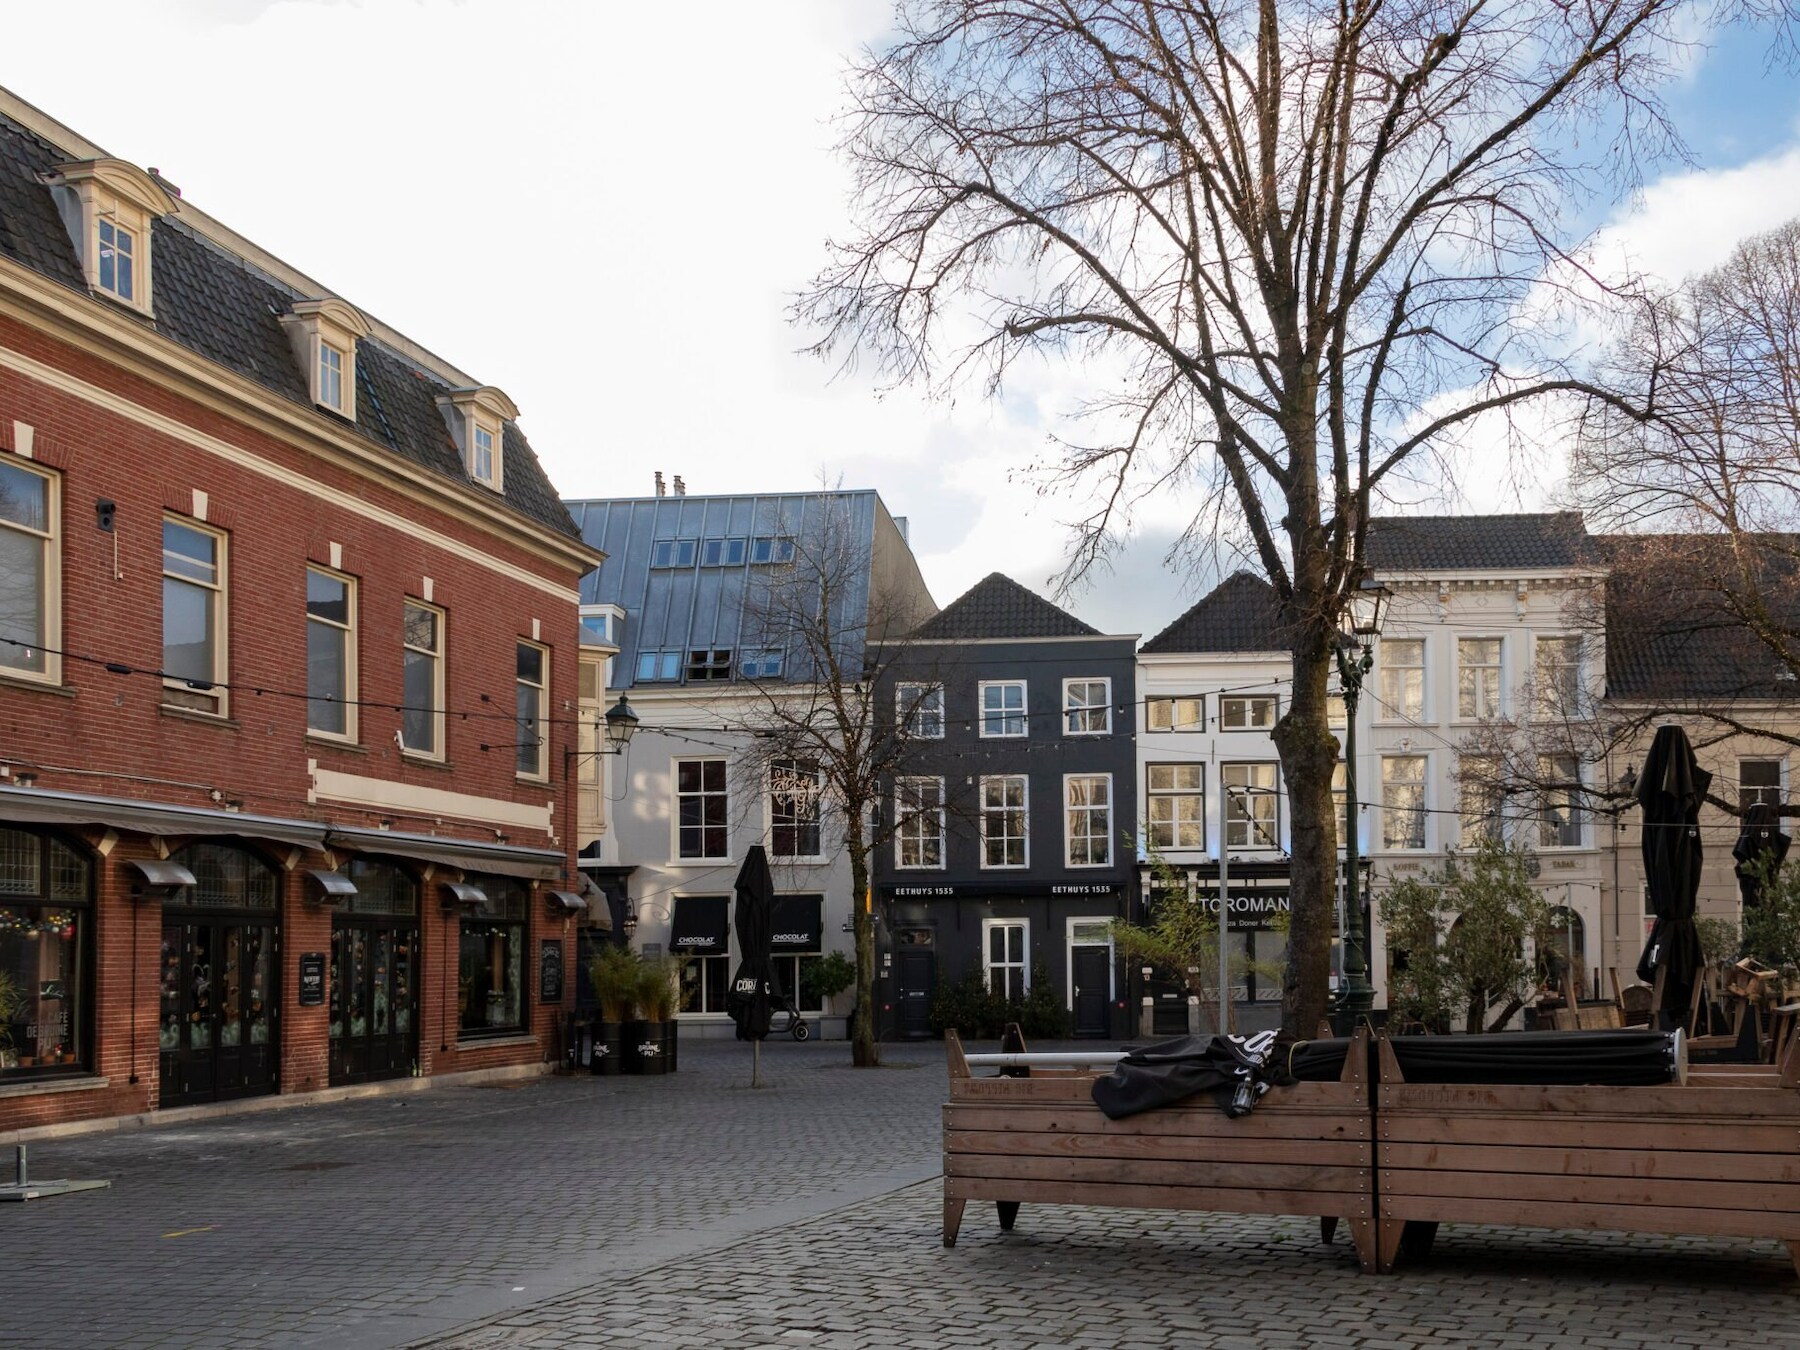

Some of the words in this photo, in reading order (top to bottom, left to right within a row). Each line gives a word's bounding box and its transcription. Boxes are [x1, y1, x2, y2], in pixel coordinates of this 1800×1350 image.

[1393, 862, 1420, 871] KOFFIE
[895, 887, 933, 895] EETHUYS
[934, 887, 954, 895] 1535
[1052, 885, 1090, 893] EETHUYS
[1091, 885, 1111, 893] 1535
[772, 933, 809, 941] CHOCOLAT
[26, 1026, 38, 1039] DE
